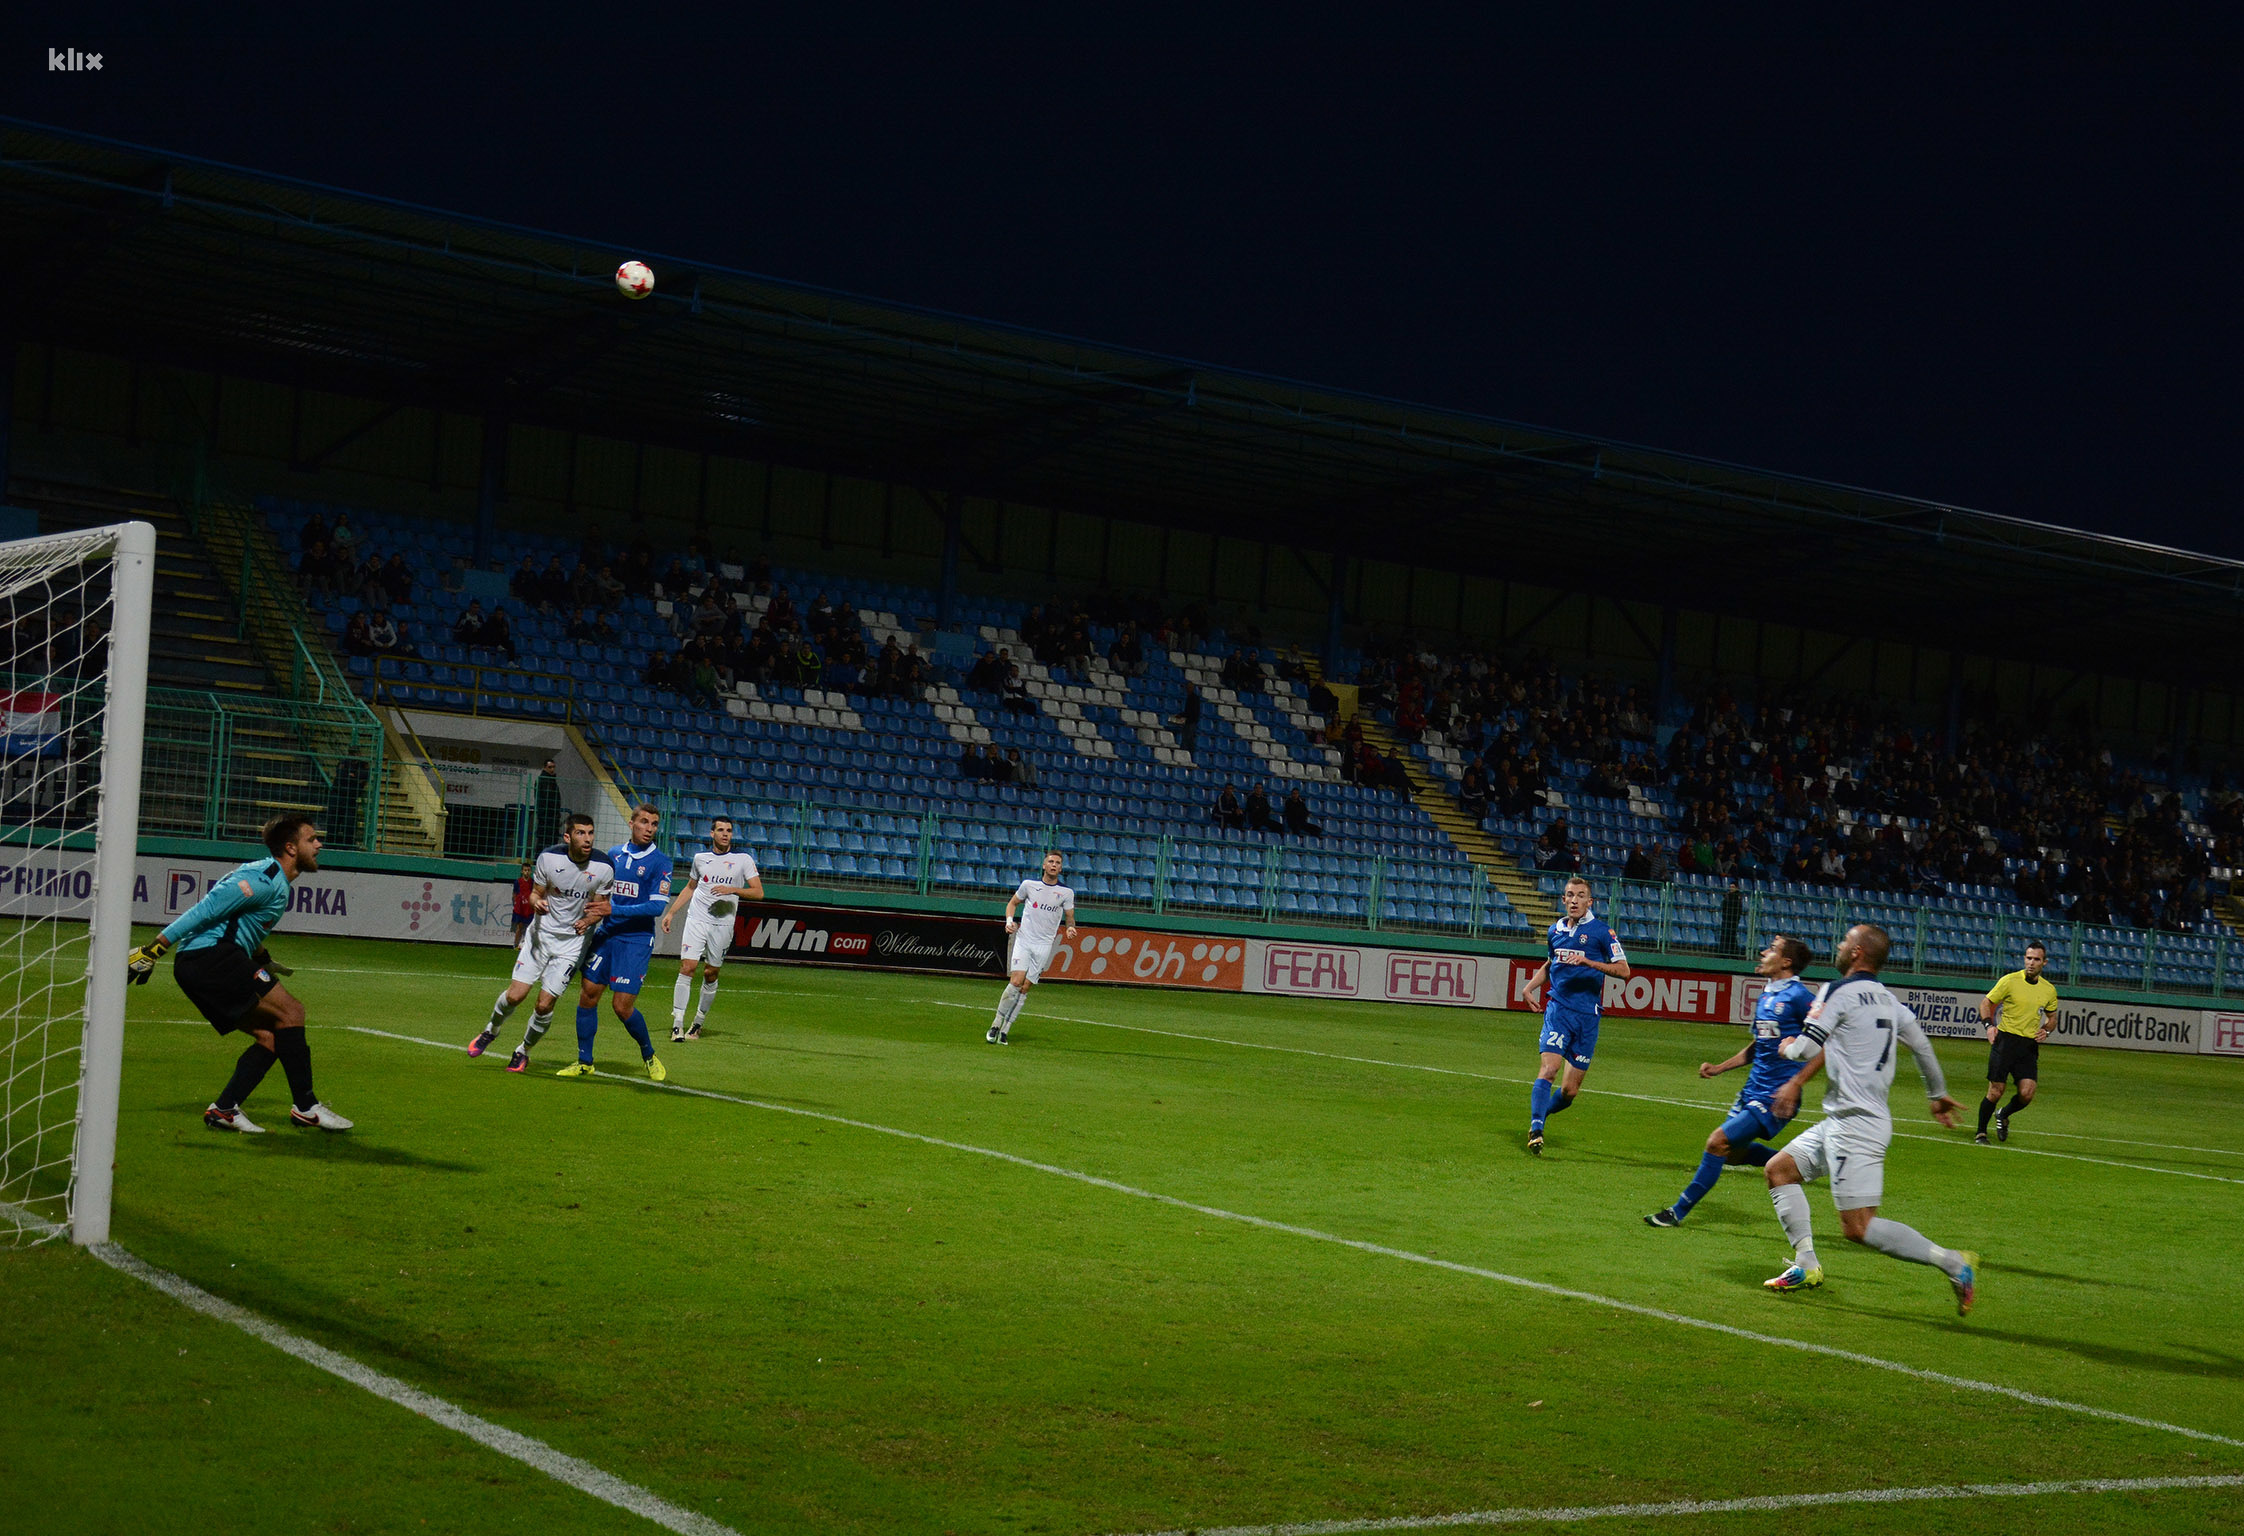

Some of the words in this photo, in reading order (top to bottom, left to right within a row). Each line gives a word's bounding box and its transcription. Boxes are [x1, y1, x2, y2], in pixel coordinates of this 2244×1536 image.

[446, 784, 470, 794] EXIT
[0, 865, 148, 902] PRIMOA
[613, 881, 637, 897] EAL
[483, 929, 515, 938] ELECTR
[833, 936, 867, 950] com
[875, 929, 944, 956] Williams
[945, 938, 997, 968] betting
[1133, 939, 1186, 980] bh
[1268, 950, 1354, 991] FEAL
[1389, 958, 1471, 998] FEAL
[1601, 973, 1726, 1015] RONET
[1908, 991, 1921, 1001] BH
[1922, 993, 1958, 1005] Telecom
[1546, 1031, 1565, 1049] 24
[1875, 1018, 1893, 1071] 7
[2216, 1018, 2244, 1048] FE
[1836, 1156, 1847, 1177] 7
